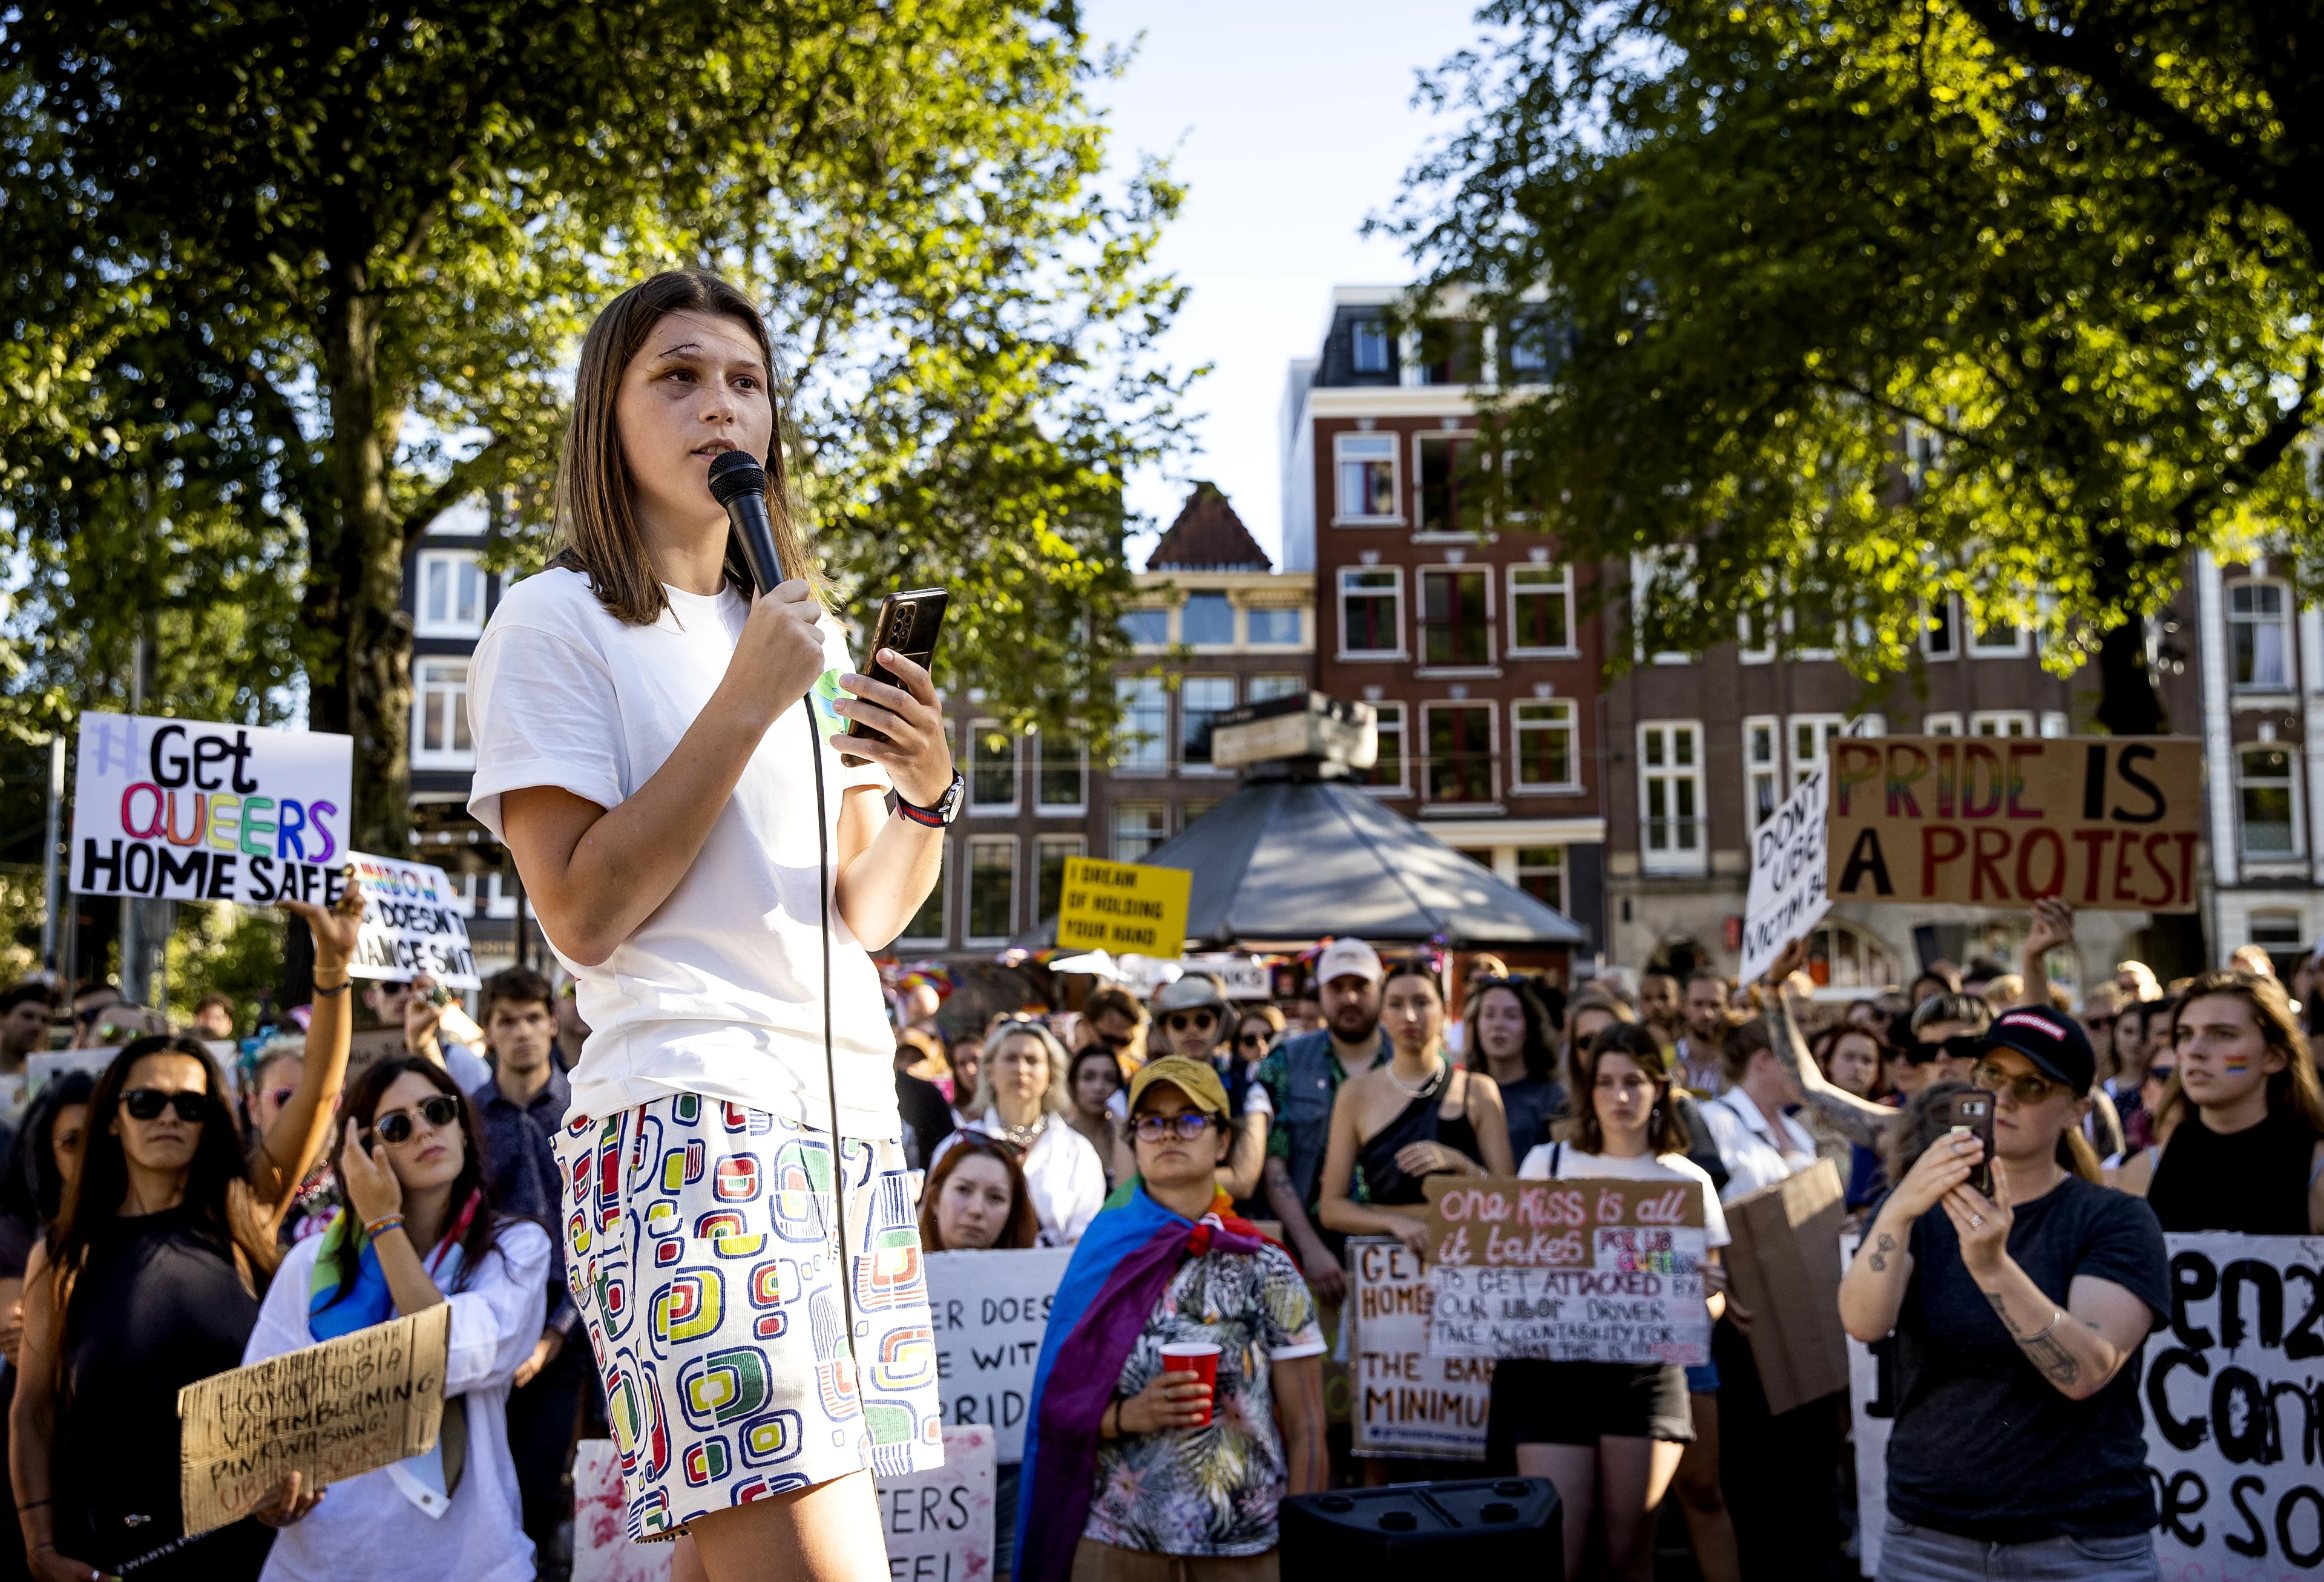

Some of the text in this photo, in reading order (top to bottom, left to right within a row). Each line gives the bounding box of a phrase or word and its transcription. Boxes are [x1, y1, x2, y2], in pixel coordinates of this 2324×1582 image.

[1837, 742, 2167, 822] PRIDE IS
[121, 781, 338, 863] QUEERS
[82, 838, 346, 907] HOME SAFE
[1771, 811, 1827, 893] UBE
[1839, 825, 2199, 907] A PROTEST
[356, 862, 438, 902] INBOW
[1070, 864, 1138, 888] I DREAM
[1068, 891, 1164, 921] OF HOLDING
[1743, 887, 1804, 962] VICTIM
[1066, 917, 1157, 947] YOUR HAND
[1596, 1187, 1624, 1224] is
[1635, 1187, 1689, 1224] all
[1438, 1224, 1586, 1265] it takes
[1477, 1270, 1530, 1295] GET
[1543, 1270, 1662, 1297] ATTACKED
[1672, 1275, 1698, 1298] BY
[1438, 1293, 1488, 1320] OUR
[1586, 1297, 1667, 1323] DRIVER
[220, 1347, 402, 1424] HOMOPHOBIA
[1362, 1352, 1422, 1382] THE
[878, 1484, 970, 1534] ERS
